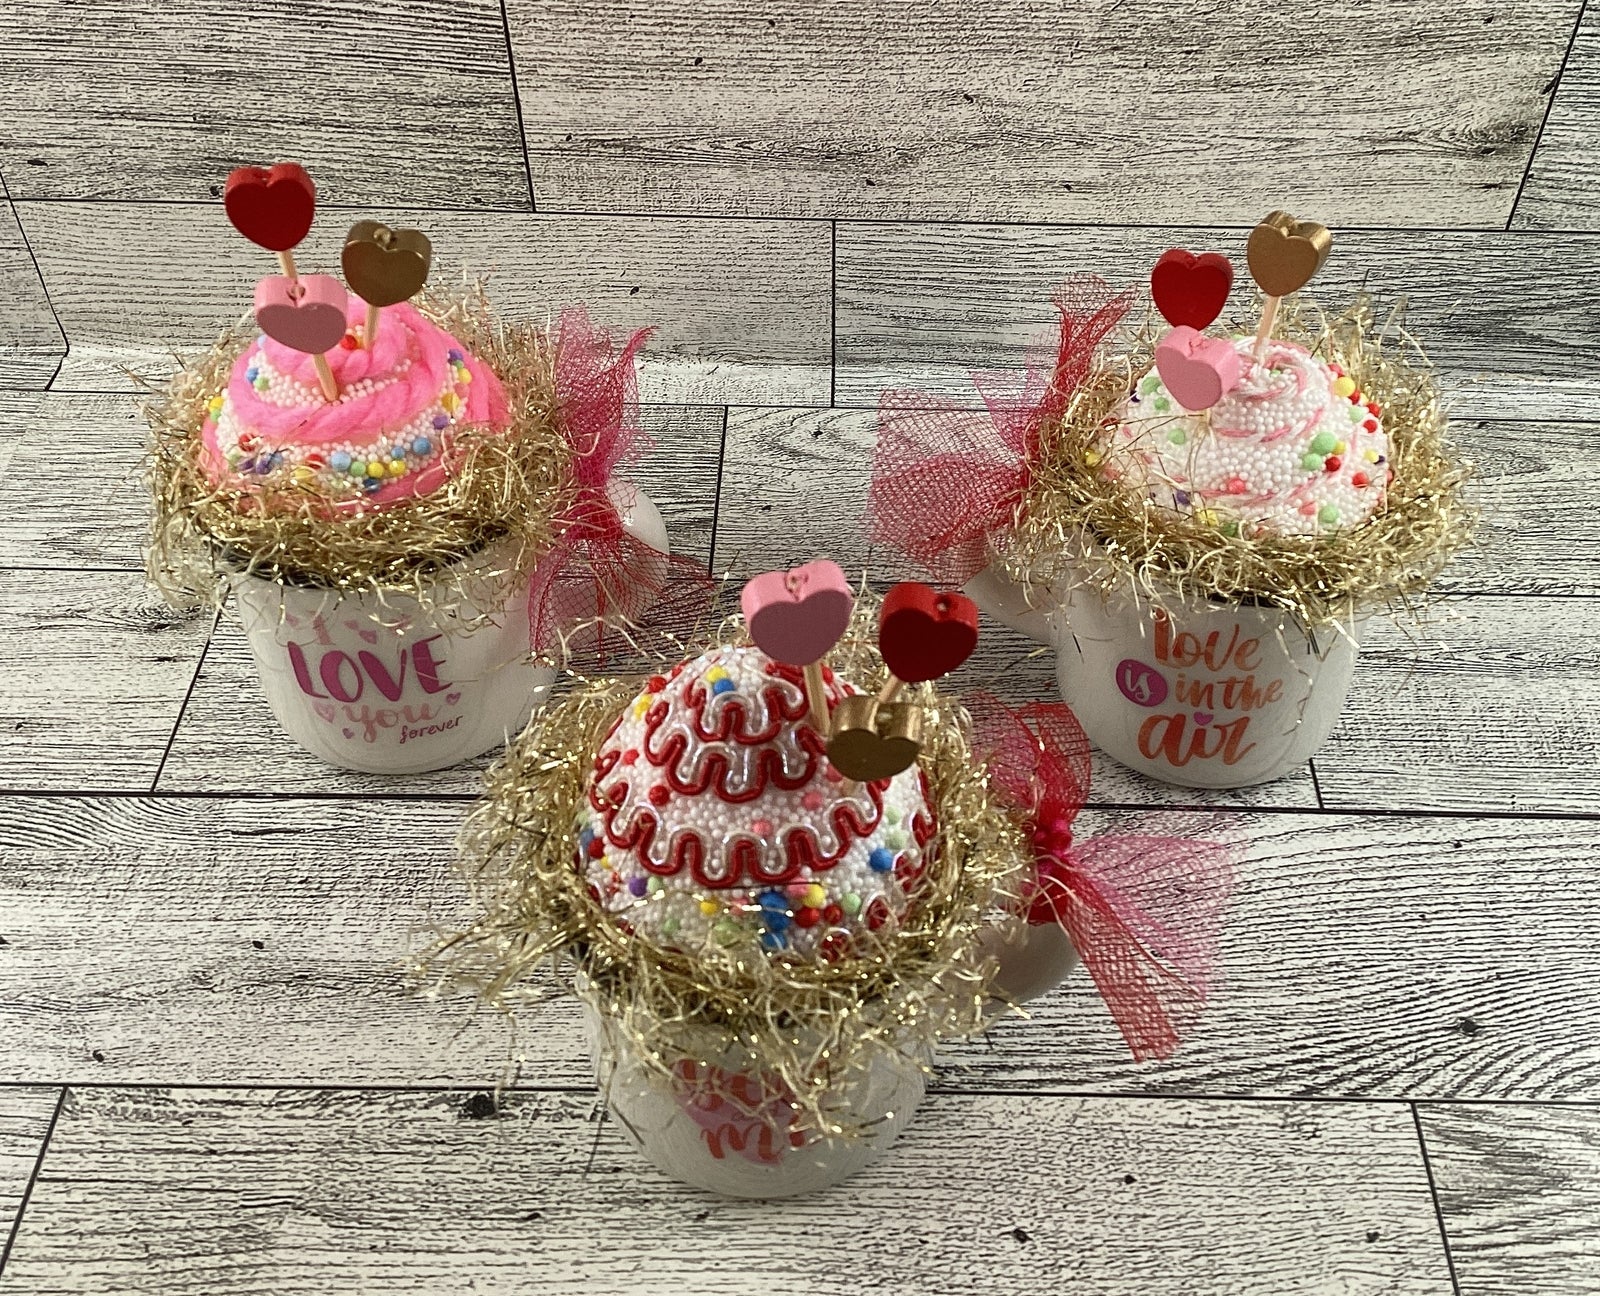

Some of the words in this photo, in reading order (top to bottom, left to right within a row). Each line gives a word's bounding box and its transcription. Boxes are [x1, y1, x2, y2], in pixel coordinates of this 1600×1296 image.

[1154, 607, 1263, 672] love
[287, 634, 453, 703] LOVE
[1124, 664, 1153, 701] is
[1175, 673, 1215, 710] in
[1216, 675, 1284, 711] the
[341, 703, 442, 743] you
[400, 716, 464, 744] forever
[1137, 711, 1257, 767] air
